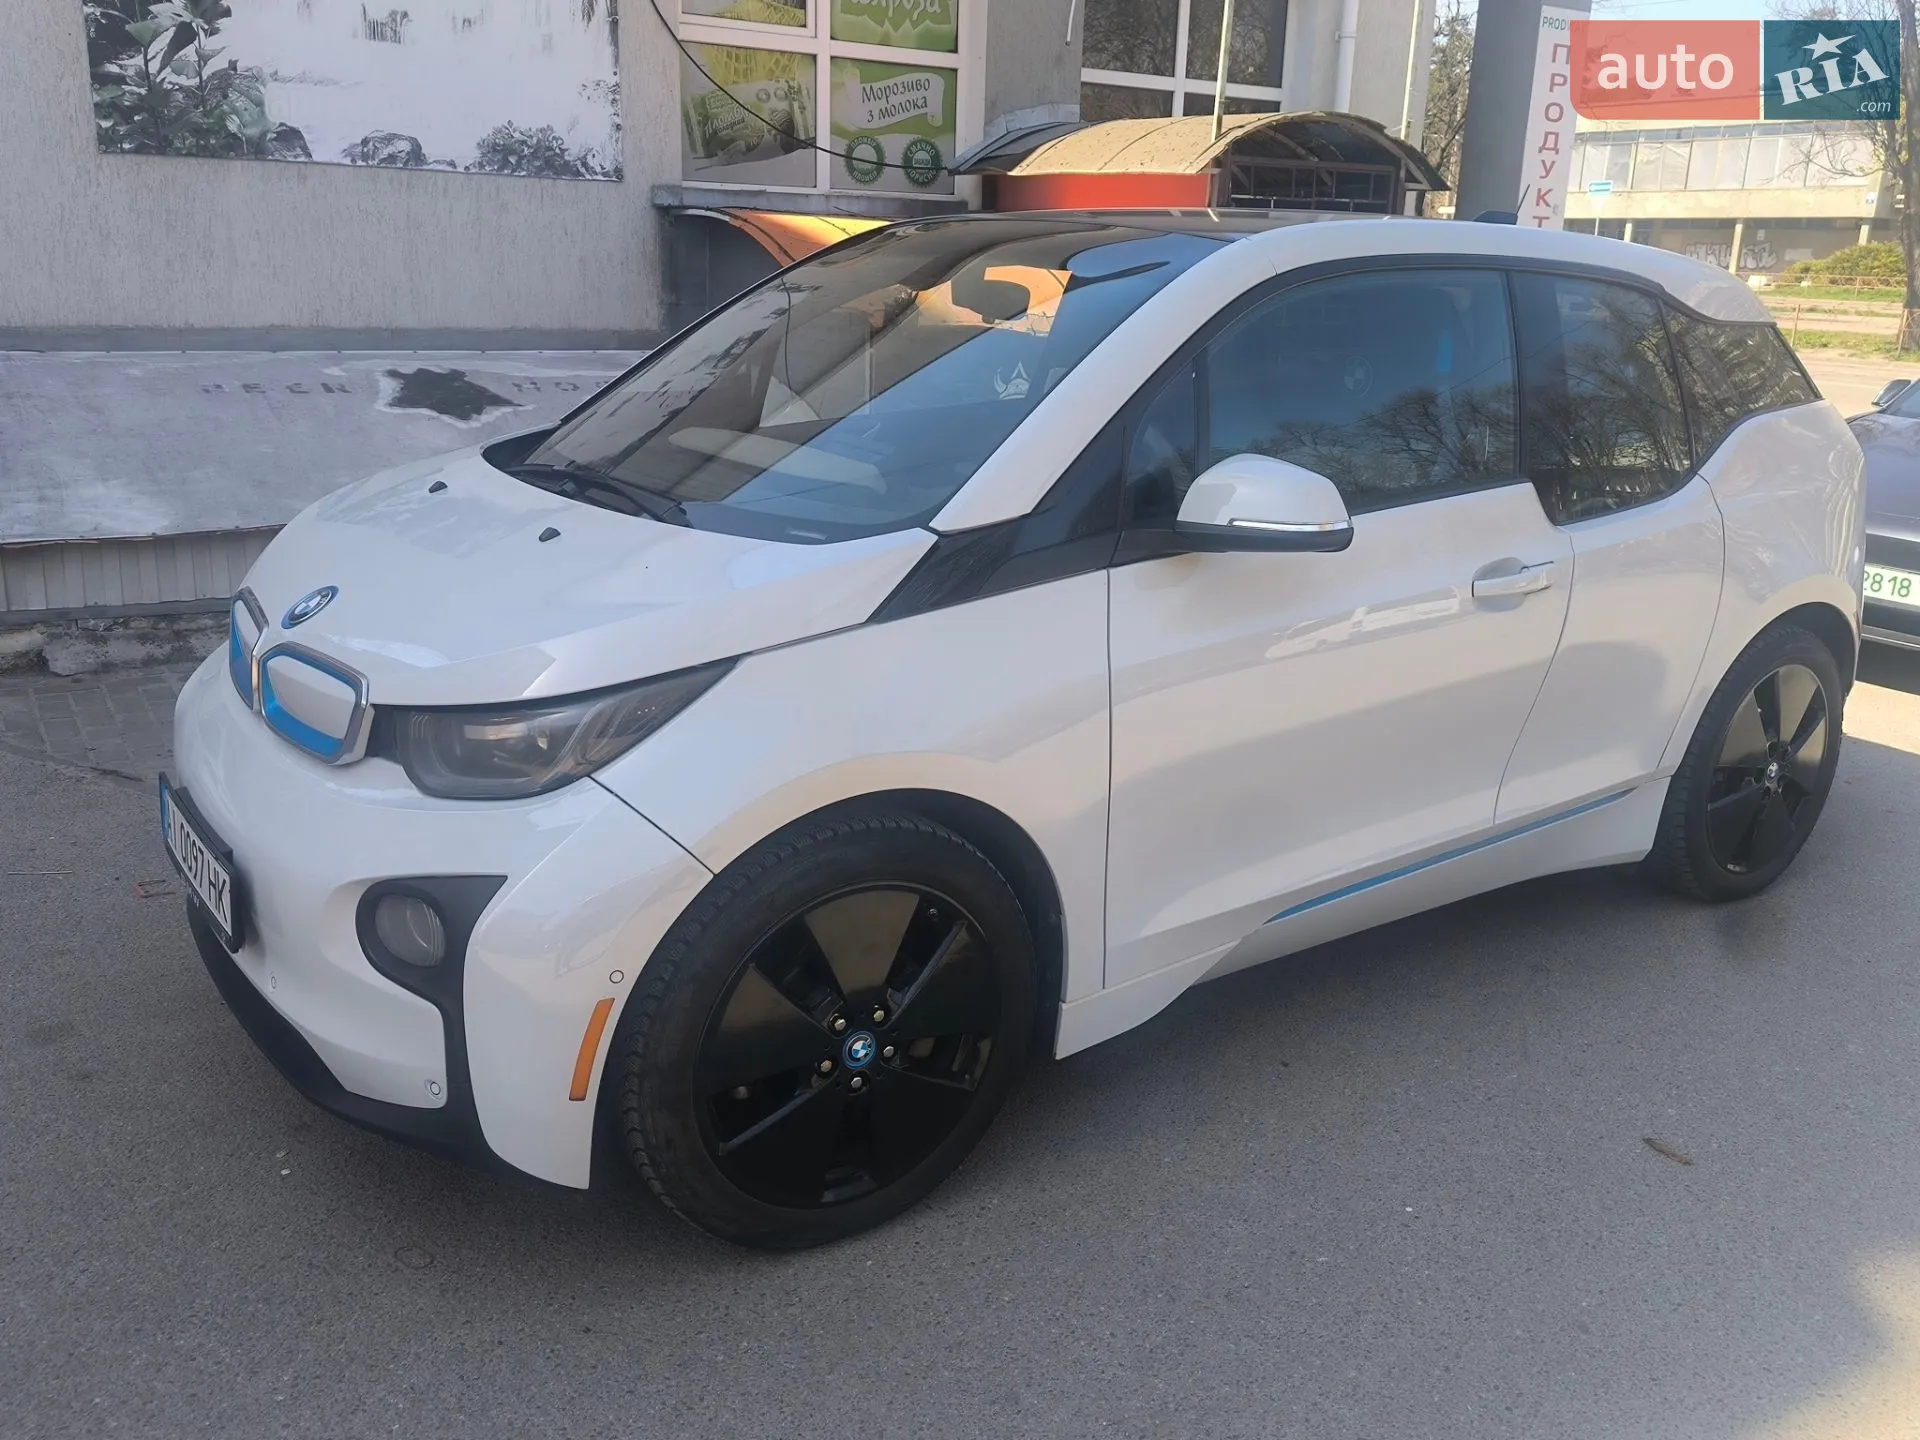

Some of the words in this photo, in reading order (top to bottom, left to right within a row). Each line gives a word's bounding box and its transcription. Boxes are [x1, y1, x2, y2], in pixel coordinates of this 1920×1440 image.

[861, 78, 931, 105] Морозиво
[866, 110, 874, 123] з
[878, 96, 928, 121] молока
[180, 821, 205, 889] 0097
[207, 858, 228, 924] HK
